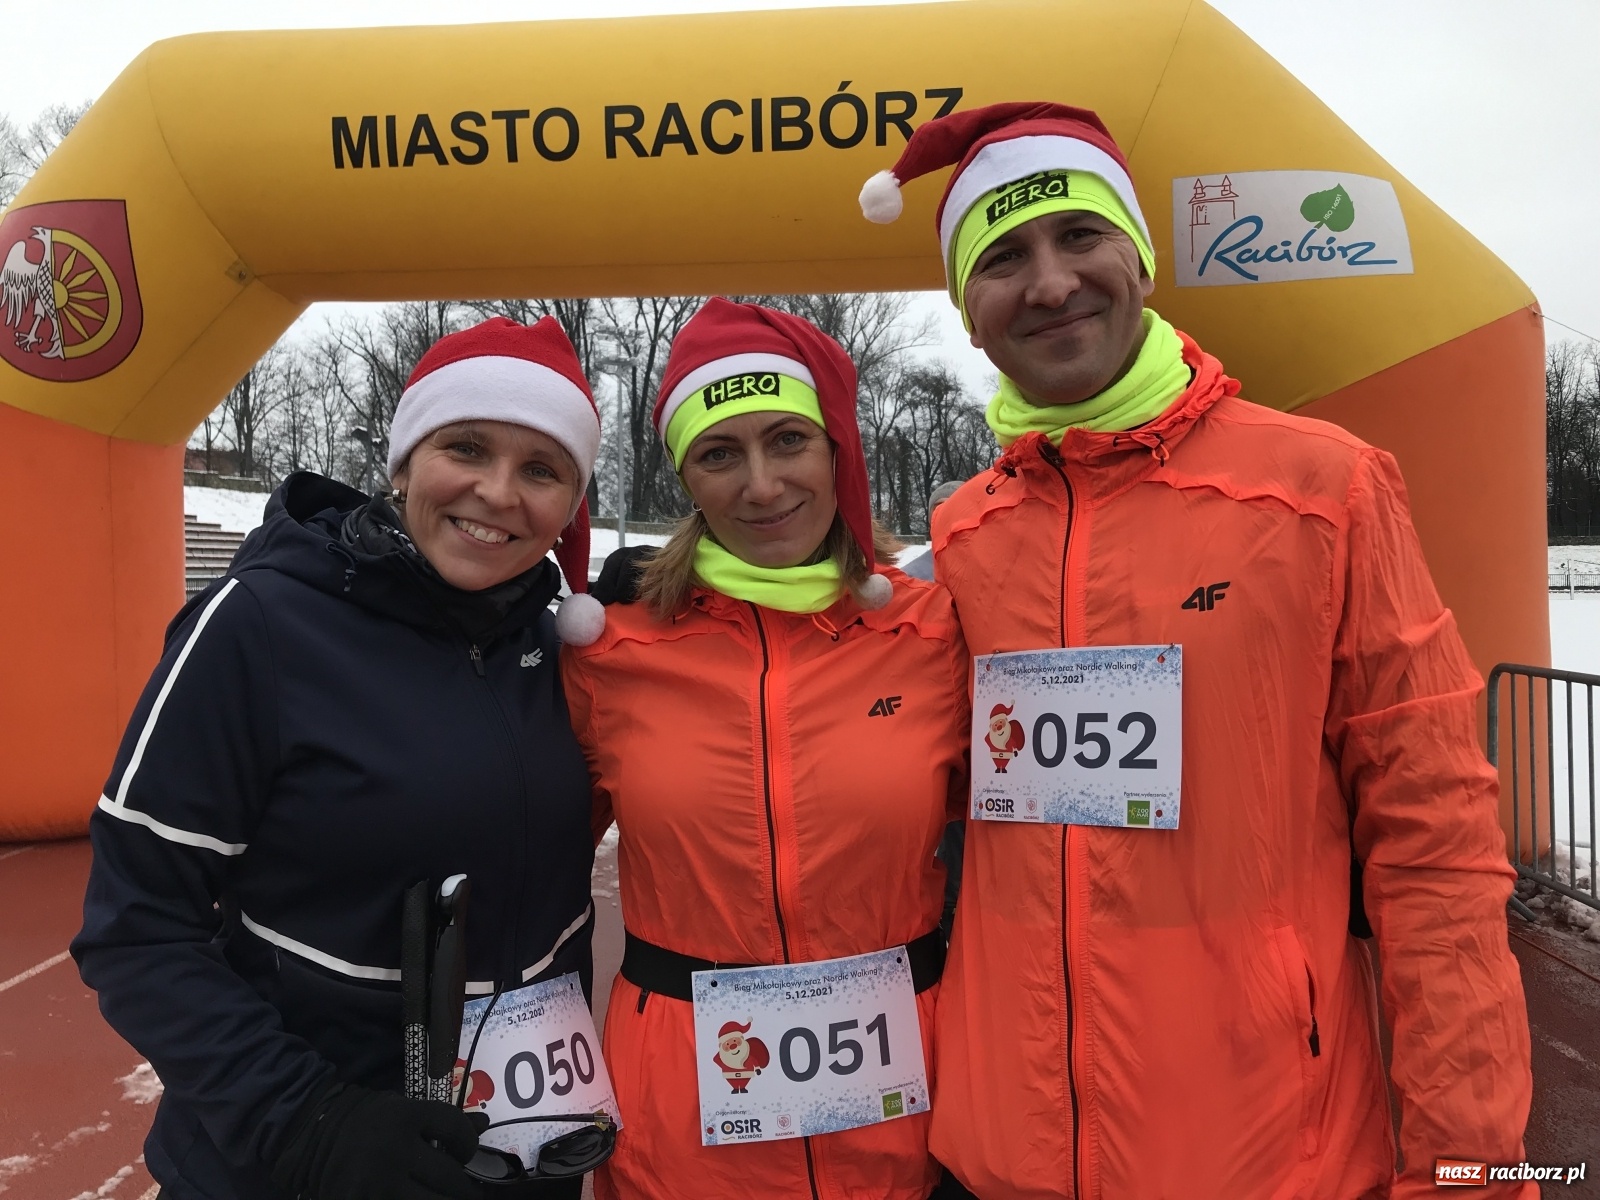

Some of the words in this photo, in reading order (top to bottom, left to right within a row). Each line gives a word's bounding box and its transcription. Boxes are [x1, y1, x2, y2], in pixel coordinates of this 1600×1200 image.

[332, 107, 580, 169] MIASTO
[604, 80, 964, 159] RACIBÓRZ
[994, 179, 1064, 217] HERO
[1323, 209, 1333, 220] ISO
[1331, 193, 1342, 210] 14001
[1198, 215, 1398, 281] Racibórz
[710, 374, 777, 402] HERO
[1181, 581, 1231, 612] 4F
[1076, 663, 1102, 671] Nordic
[1104, 661, 1138, 671] Walking
[1041, 675, 1084, 685] 5.12.2021
[867, 695, 902, 717] 4F
[1032, 711, 1158, 770] 052
[985, 798, 1015, 813] OSiR
[753, 979, 802, 990] Mikołajkowy
[804, 978, 821, 986] oraz
[823, 972, 849, 983] Nordic
[850, 968, 878, 978] Walking
[785, 986, 833, 1000] 5.12.2021
[474, 1003, 522, 1020] Miołajkowy
[523, 1000, 536, 1008] oraz
[507, 1006, 545, 1025] 5.12.2021
[779, 1012, 891, 1082] 051
[504, 1031, 595, 1109] 050
[721, 1118, 762, 1134] OSiR
